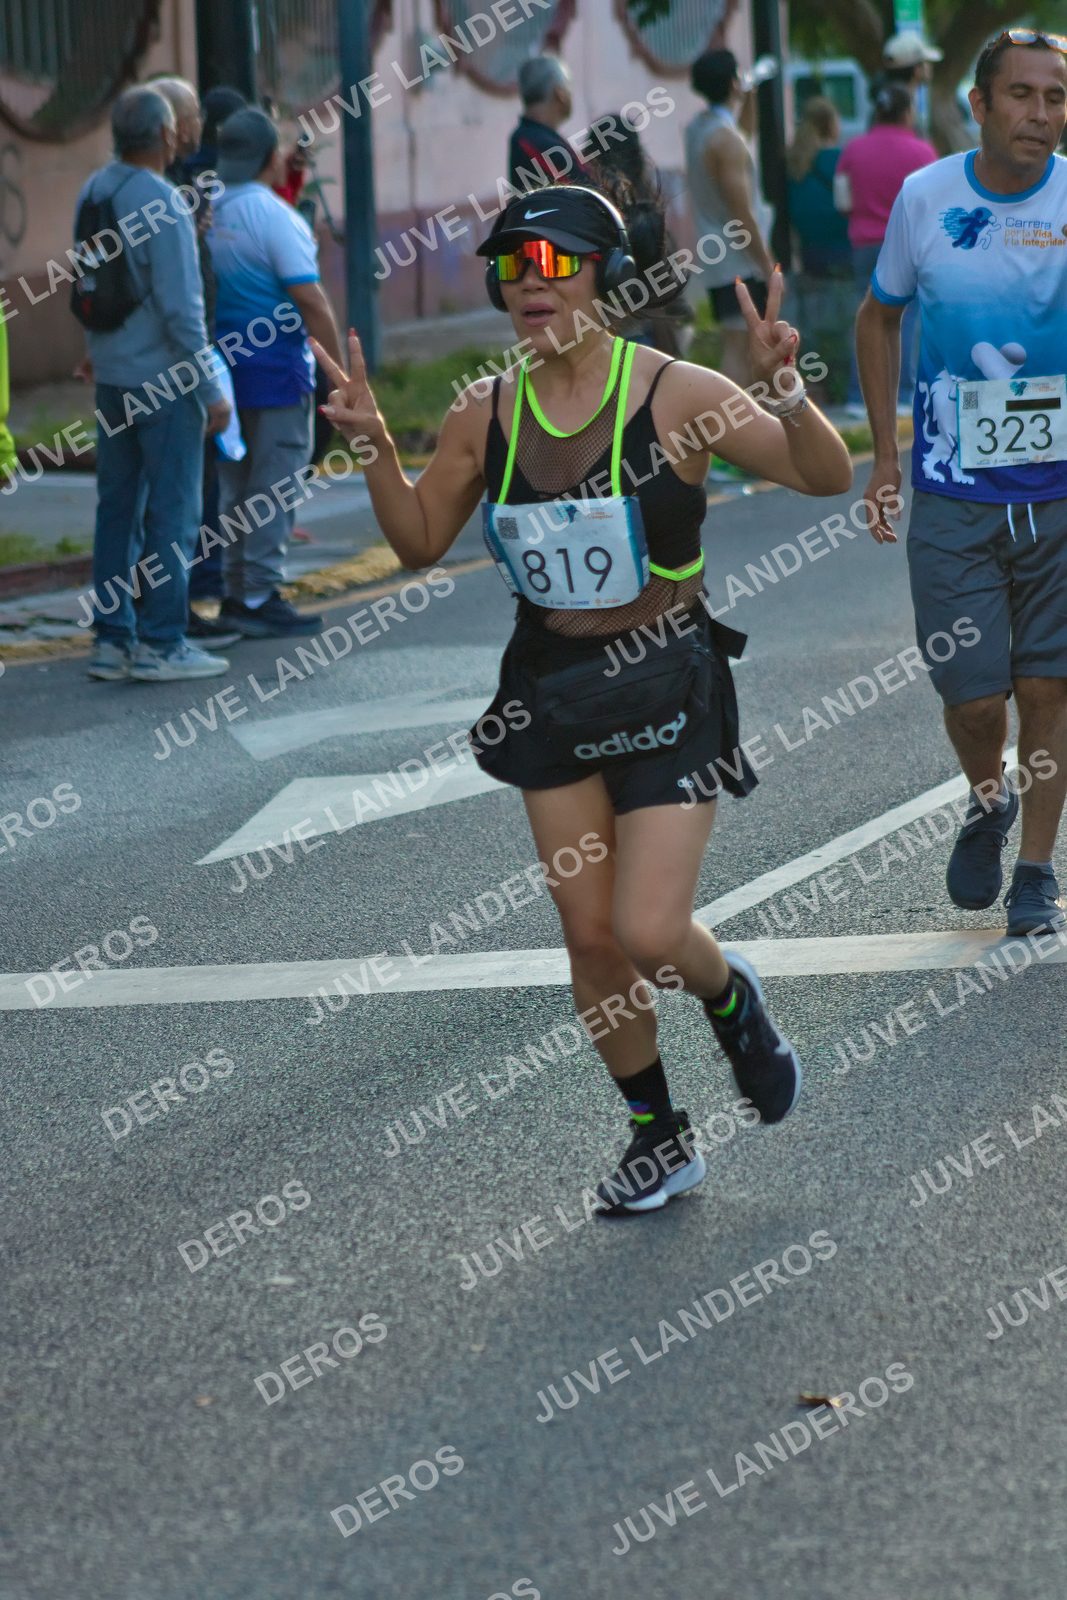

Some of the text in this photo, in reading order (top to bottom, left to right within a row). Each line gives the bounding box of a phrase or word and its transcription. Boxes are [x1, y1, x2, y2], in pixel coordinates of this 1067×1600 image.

[1005, 217, 1051, 230] Carrera
[1033, 229, 1052, 238] Vida
[976, 413, 1053, 455] 323
[522, 546, 613, 594] 819
